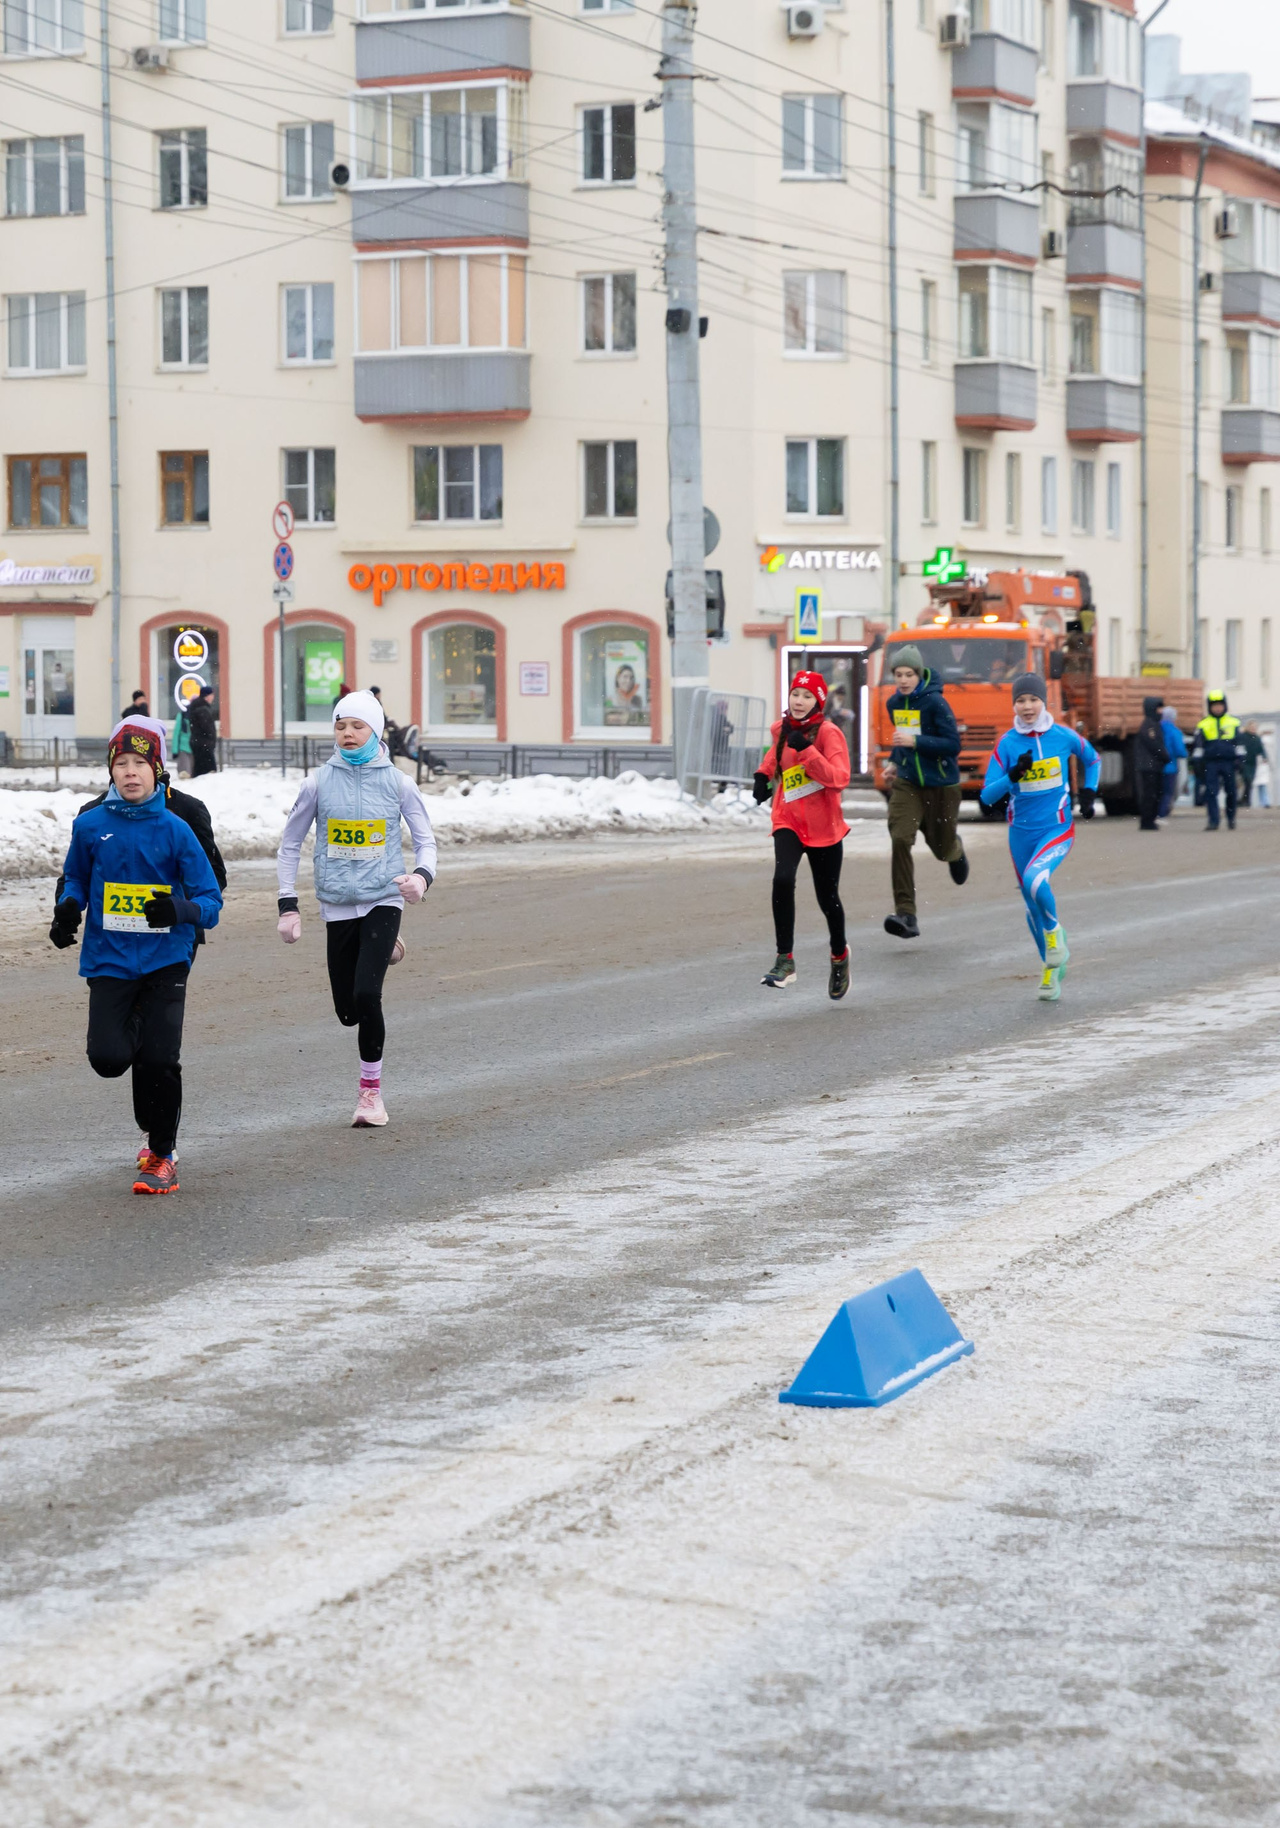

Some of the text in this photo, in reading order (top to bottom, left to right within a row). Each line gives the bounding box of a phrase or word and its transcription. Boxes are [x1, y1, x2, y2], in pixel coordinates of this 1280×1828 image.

[787, 550, 882, 569] АПТЕКА
[347, 562, 565, 607] ортопедия
[308, 657, 341, 681] 30
[784, 773, 803, 790] 239
[333, 828, 365, 845] 238
[109, 894, 147, 914] 233
